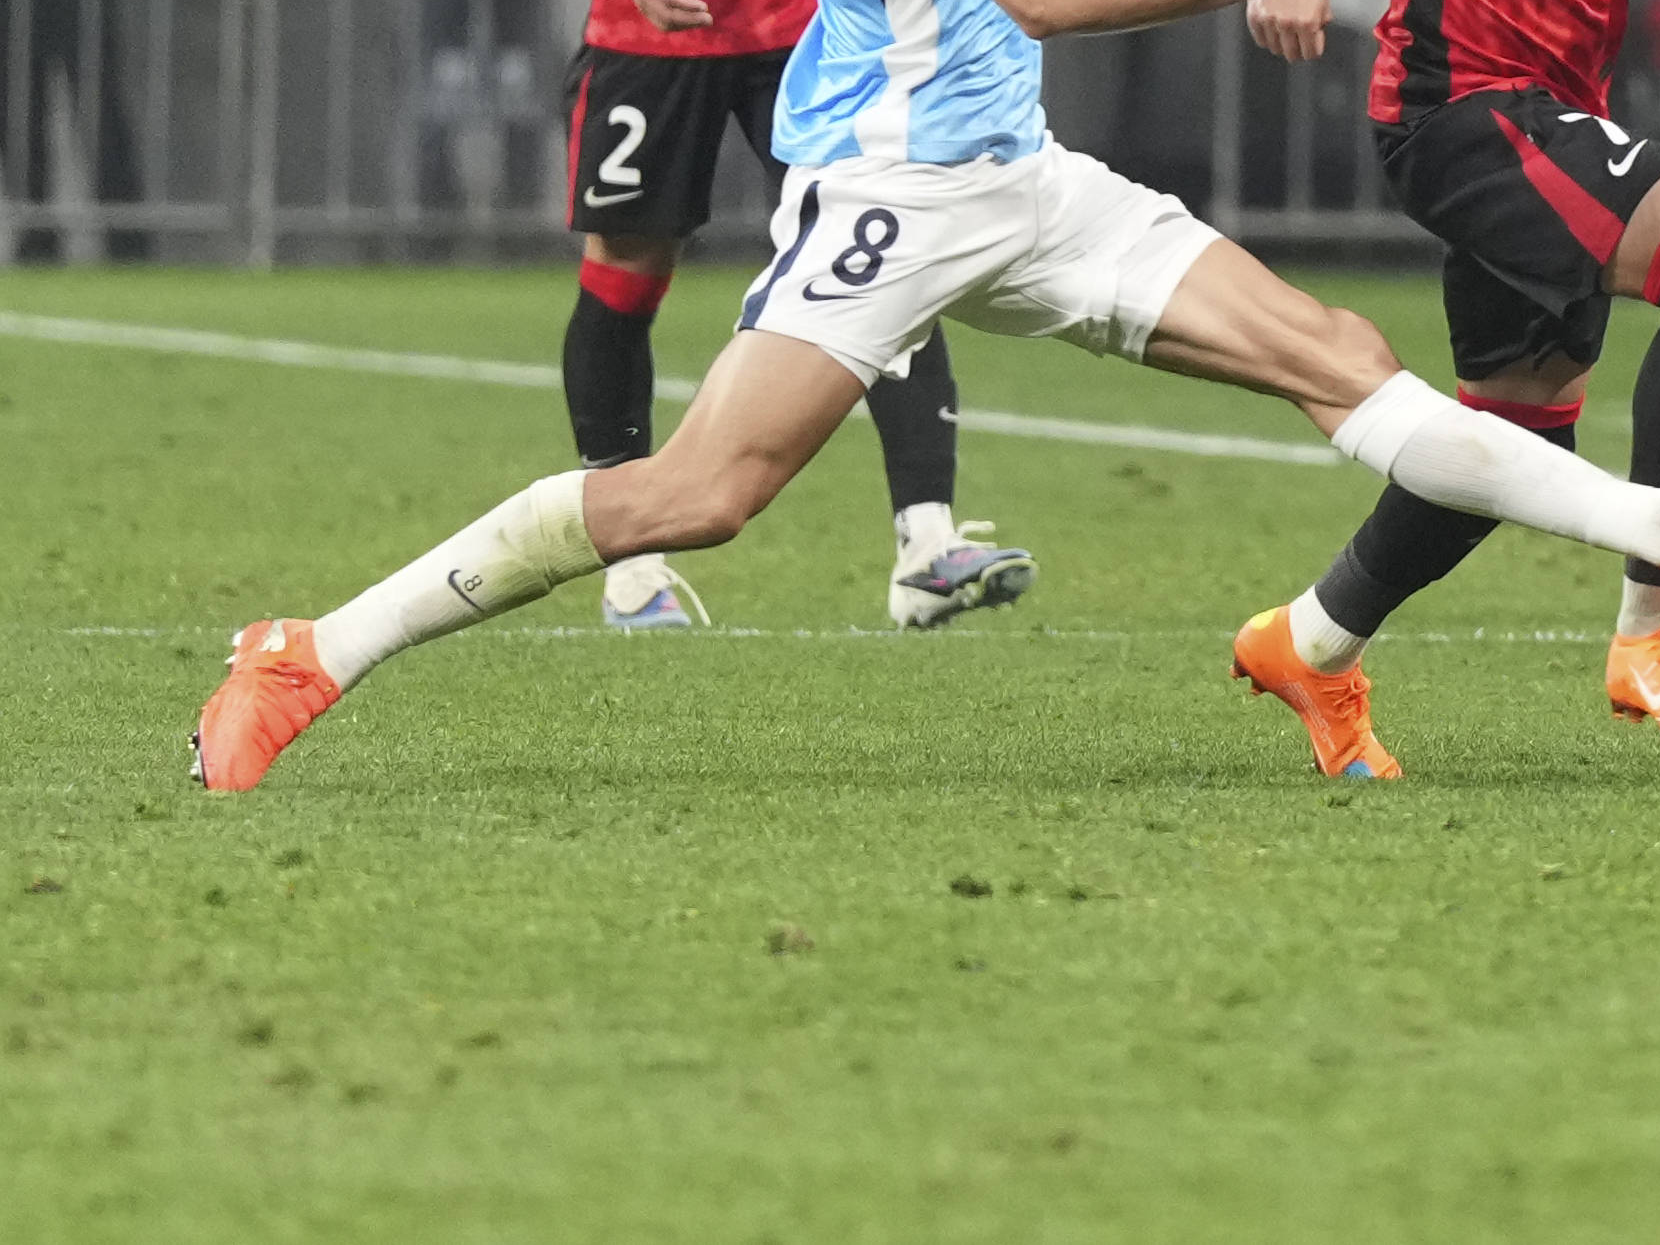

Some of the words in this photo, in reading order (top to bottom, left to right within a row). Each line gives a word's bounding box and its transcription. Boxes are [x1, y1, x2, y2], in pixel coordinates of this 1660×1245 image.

[599, 104, 648, 187] 2
[831, 207, 900, 287] 8
[463, 574, 484, 592] 8
